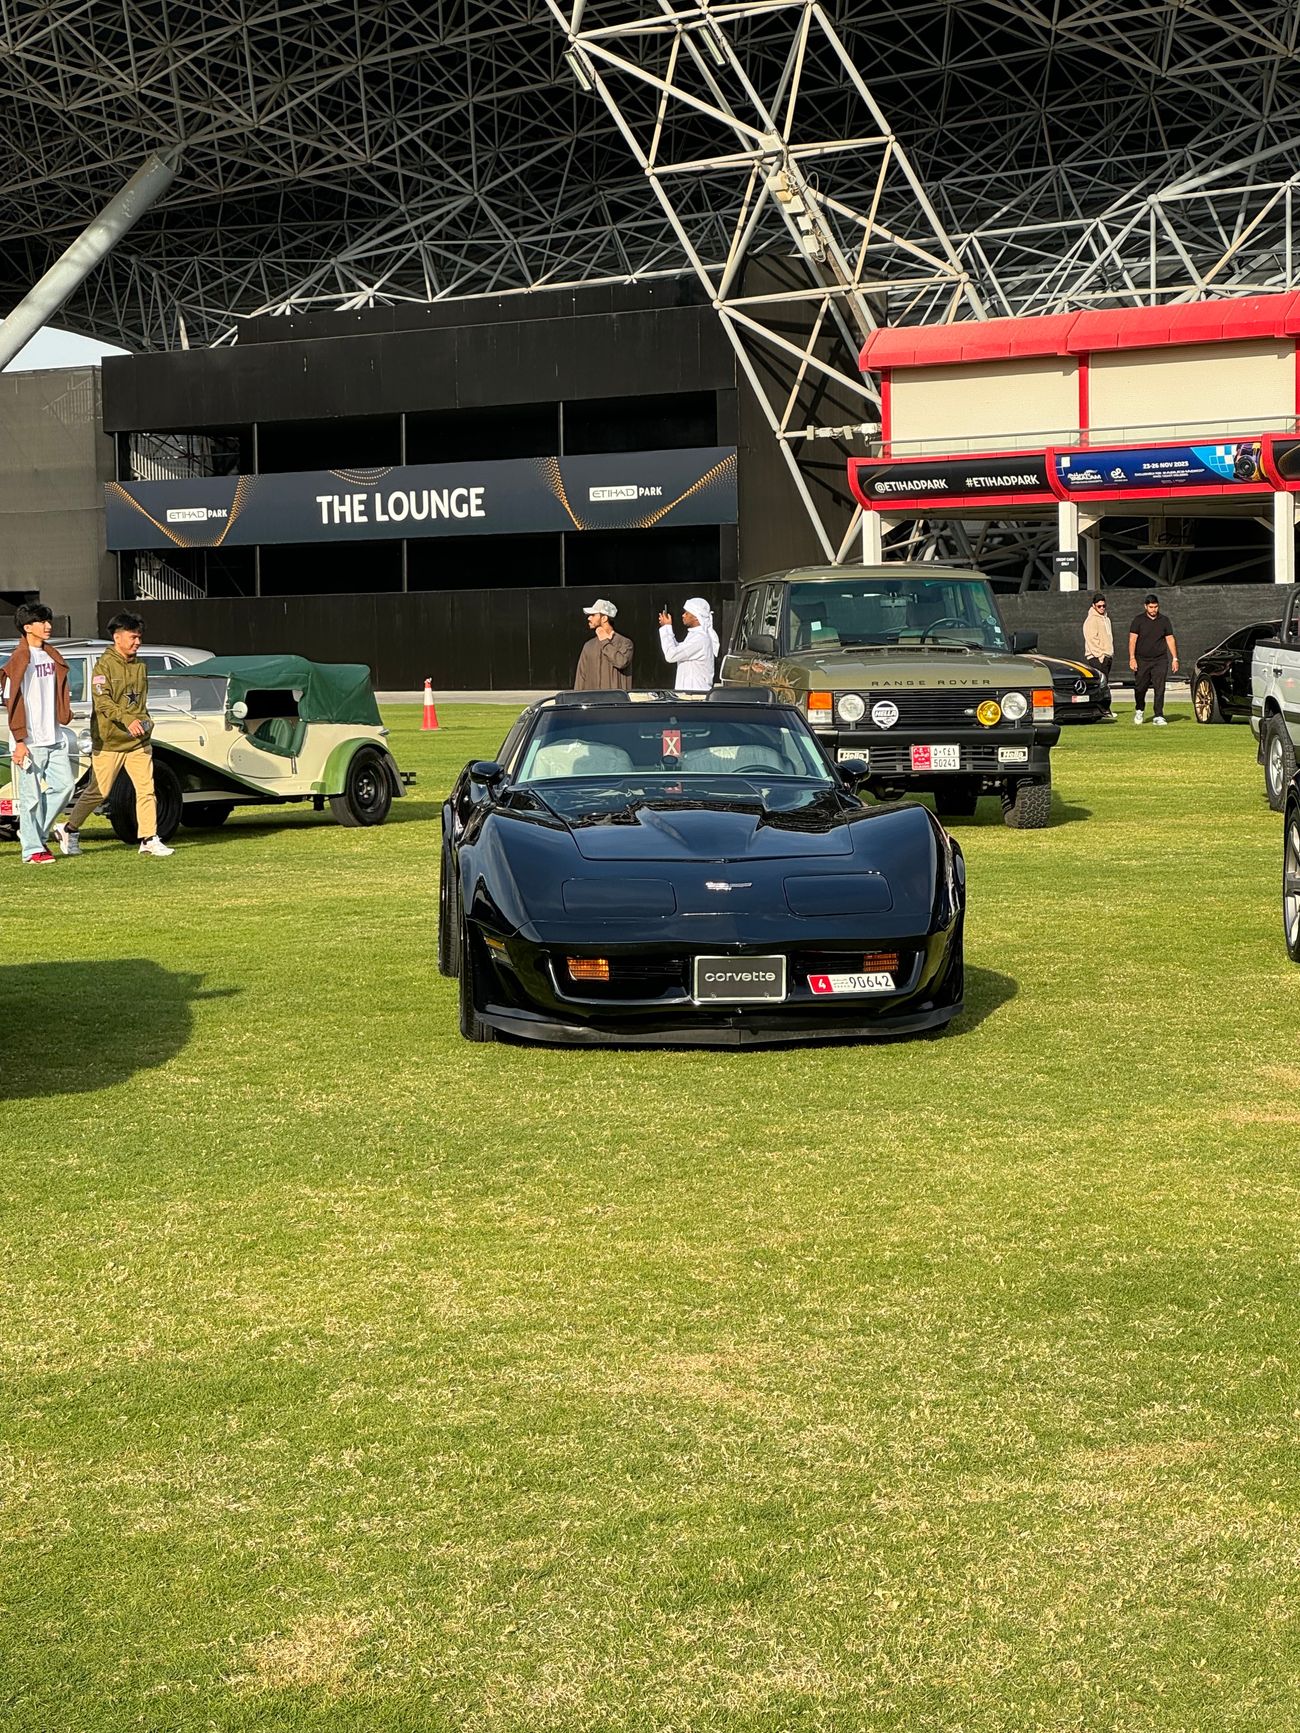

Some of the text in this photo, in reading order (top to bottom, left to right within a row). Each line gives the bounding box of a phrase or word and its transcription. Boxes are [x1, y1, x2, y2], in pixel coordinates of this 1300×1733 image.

[875, 479, 948, 493] @ETIHADPARK
[965, 475, 1039, 488] #ETIHADPARK
[592, 487, 662, 498] ETIHAD PARK
[316, 487, 485, 524] THE LOUNGE
[169, 509, 227, 519] ETIHAD PARK
[873, 710, 897, 718] HELLA
[664, 736, 680, 755] X
[933, 759, 956, 768] 50241
[704, 971, 776, 982] corvette
[818, 978, 827, 989] 4
[848, 975, 892, 989] 90642
